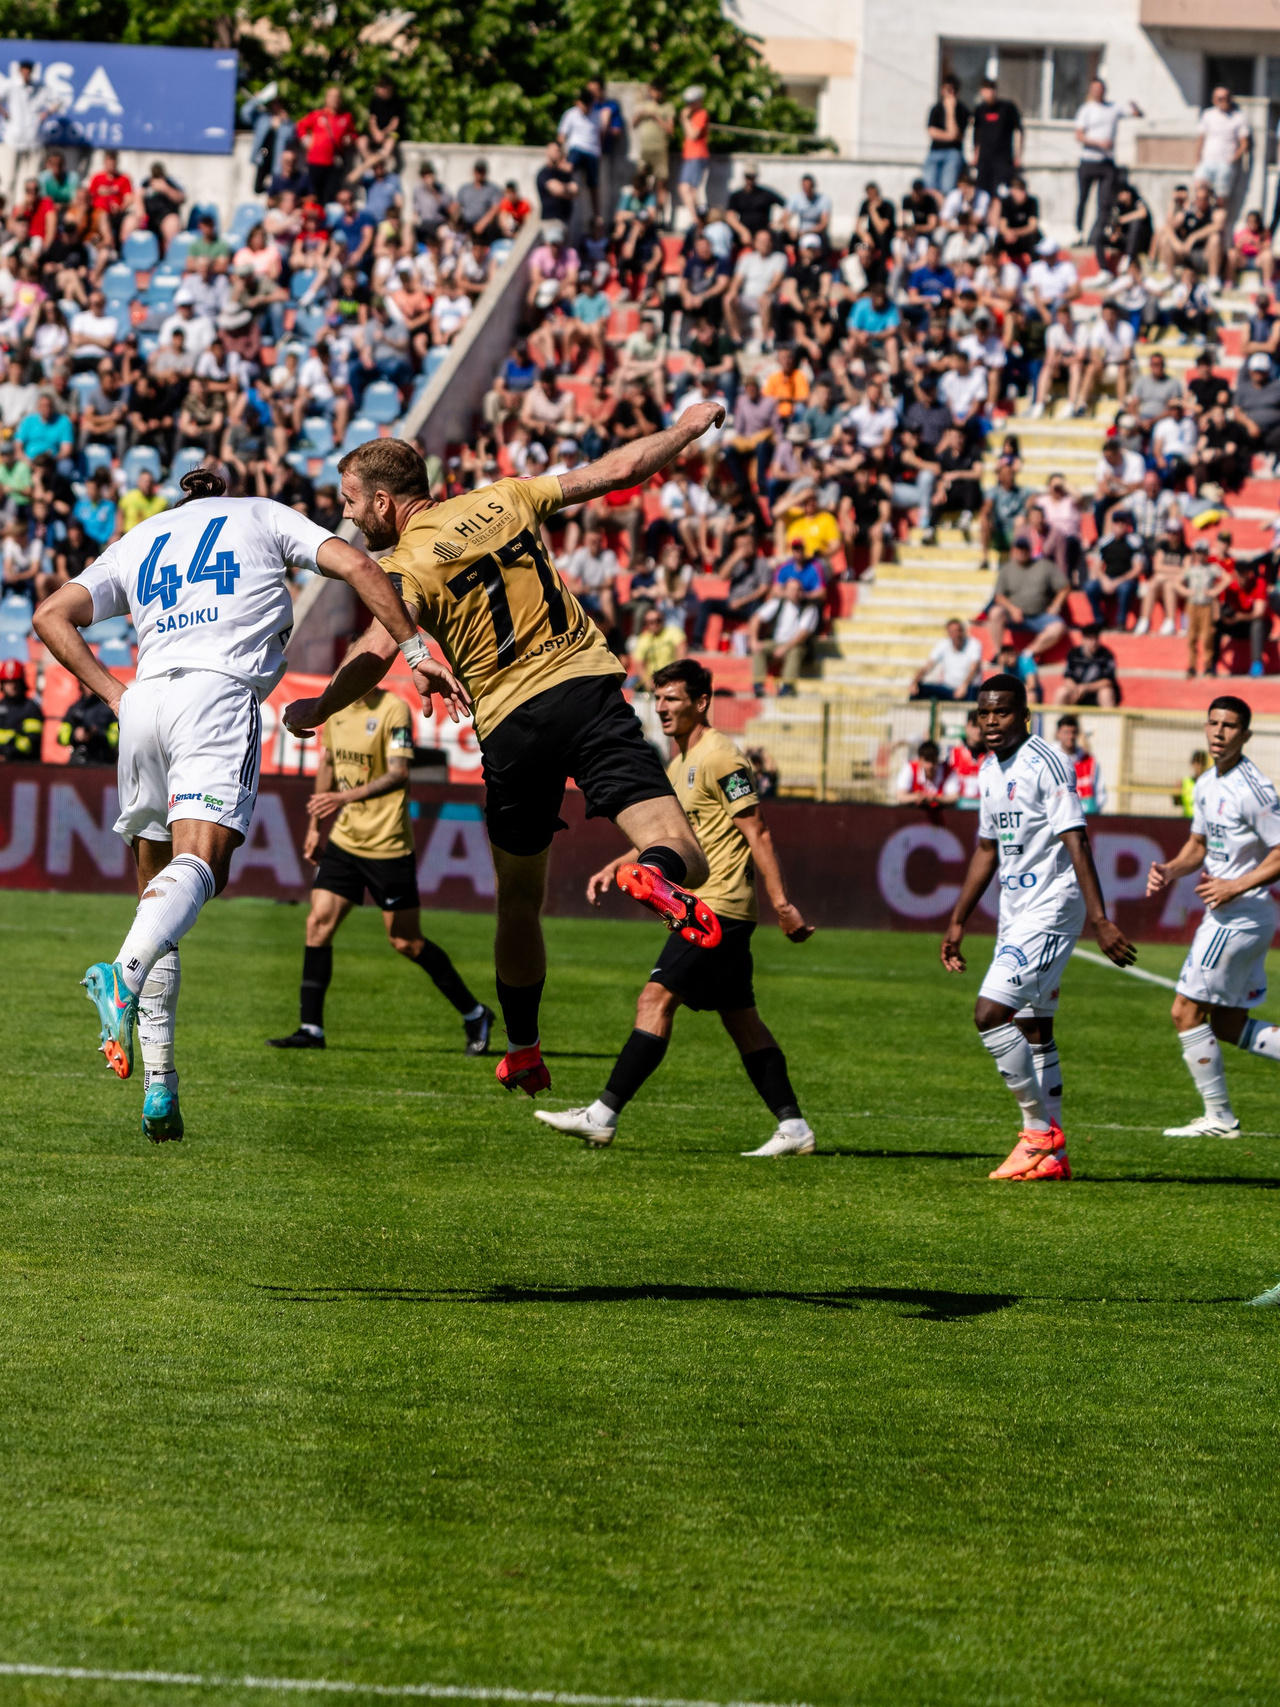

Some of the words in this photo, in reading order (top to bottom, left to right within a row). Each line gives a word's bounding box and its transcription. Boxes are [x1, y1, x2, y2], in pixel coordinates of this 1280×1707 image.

[454, 501, 505, 538] HILS
[470, 511, 515, 546] DEVELOPMENT
[510, 542, 523, 553] FCV
[137, 515, 240, 611] 44
[466, 571, 478, 582] FCV
[445, 527, 570, 671] 77
[156, 606, 219, 634] SADIKU
[175, 792, 202, 803] Smart
[203, 795, 224, 806] Eco
[205, 803, 223, 813] Plus
